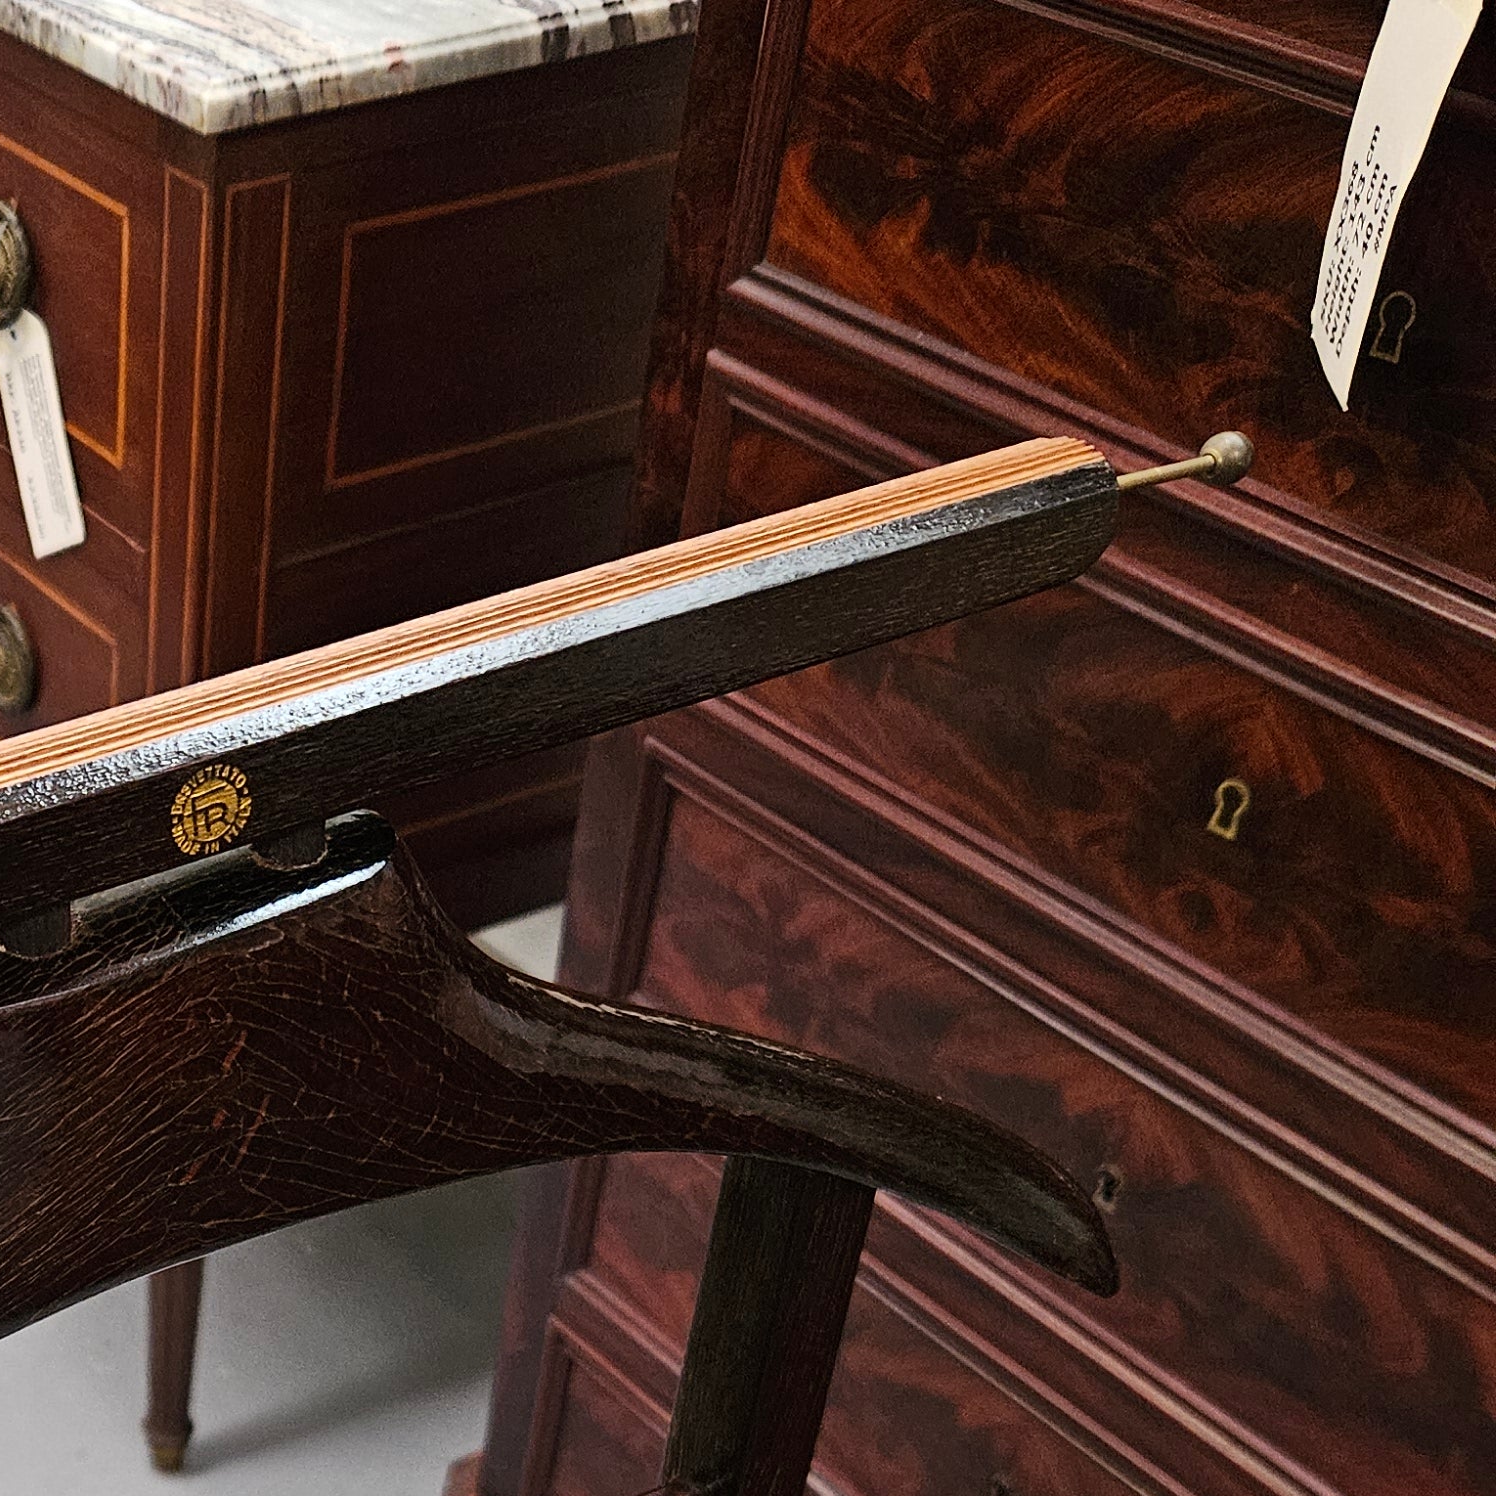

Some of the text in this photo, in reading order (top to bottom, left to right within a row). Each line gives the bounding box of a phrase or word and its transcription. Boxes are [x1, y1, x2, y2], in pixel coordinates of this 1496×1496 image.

[1325, 125, 1380, 335] Height: 143 cm
[1329, 163, 1380, 344] Width: 72 cm
[1336, 173, 1388, 358] Depth: 40 cm
[172, 825, 201, 855] MADE
[205, 841, 219, 855] IN
